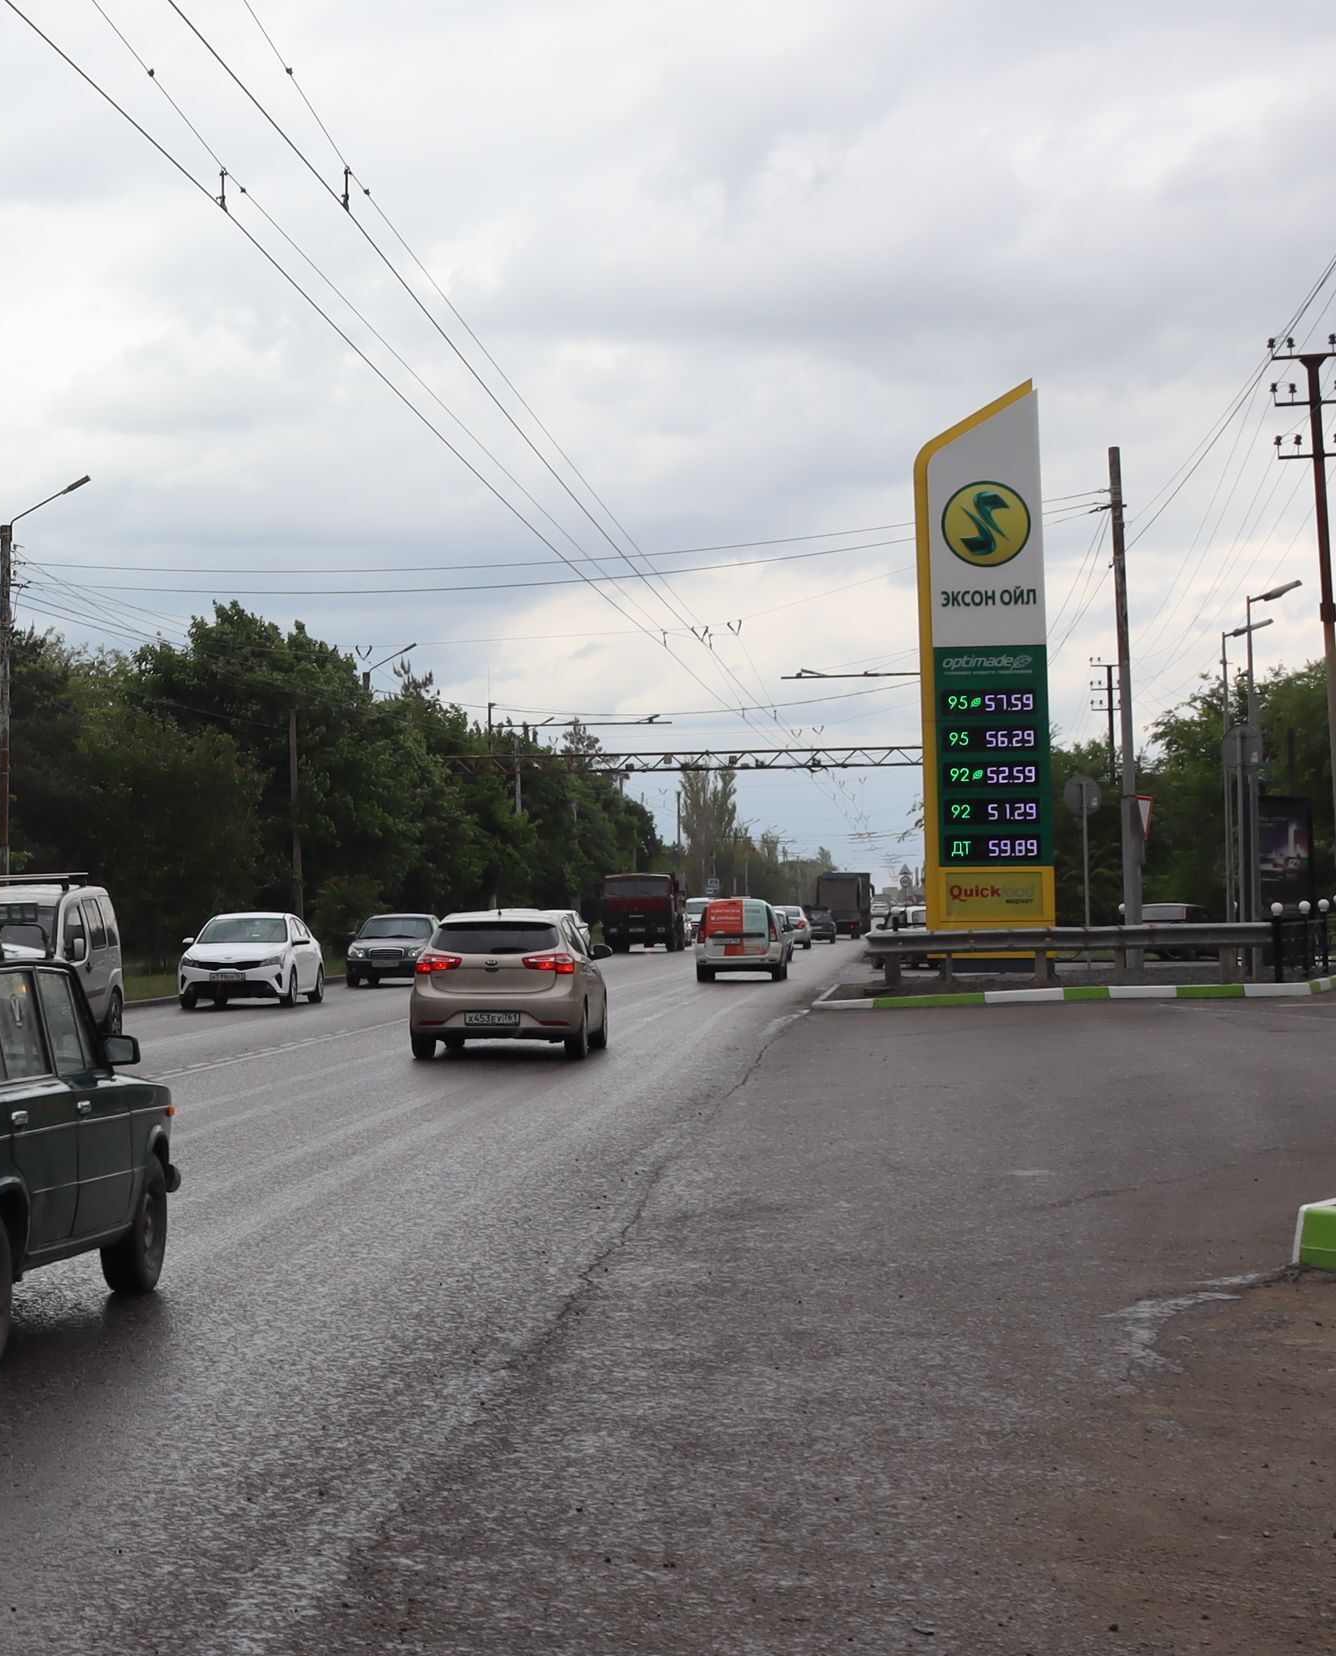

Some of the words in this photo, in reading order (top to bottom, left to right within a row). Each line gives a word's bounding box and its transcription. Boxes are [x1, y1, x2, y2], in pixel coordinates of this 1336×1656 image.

[941, 590, 995, 607] ЭКСОН
[1000, 586, 1037, 605] ОЙЛ
[942, 654, 1014, 671] optimade
[948, 696, 968, 710] 95
[985, 694, 1033, 711] 57.59
[949, 732, 969, 746] 95
[986, 730, 1035, 748] 56.29
[950, 768, 970, 782] 92
[987, 766, 1036, 784] 52.59
[951, 805, 971, 819] 92
[988, 803, 1036, 820] 51.29
[951, 841, 972, 857] ДТ
[989, 839, 1038, 857] 59.89
